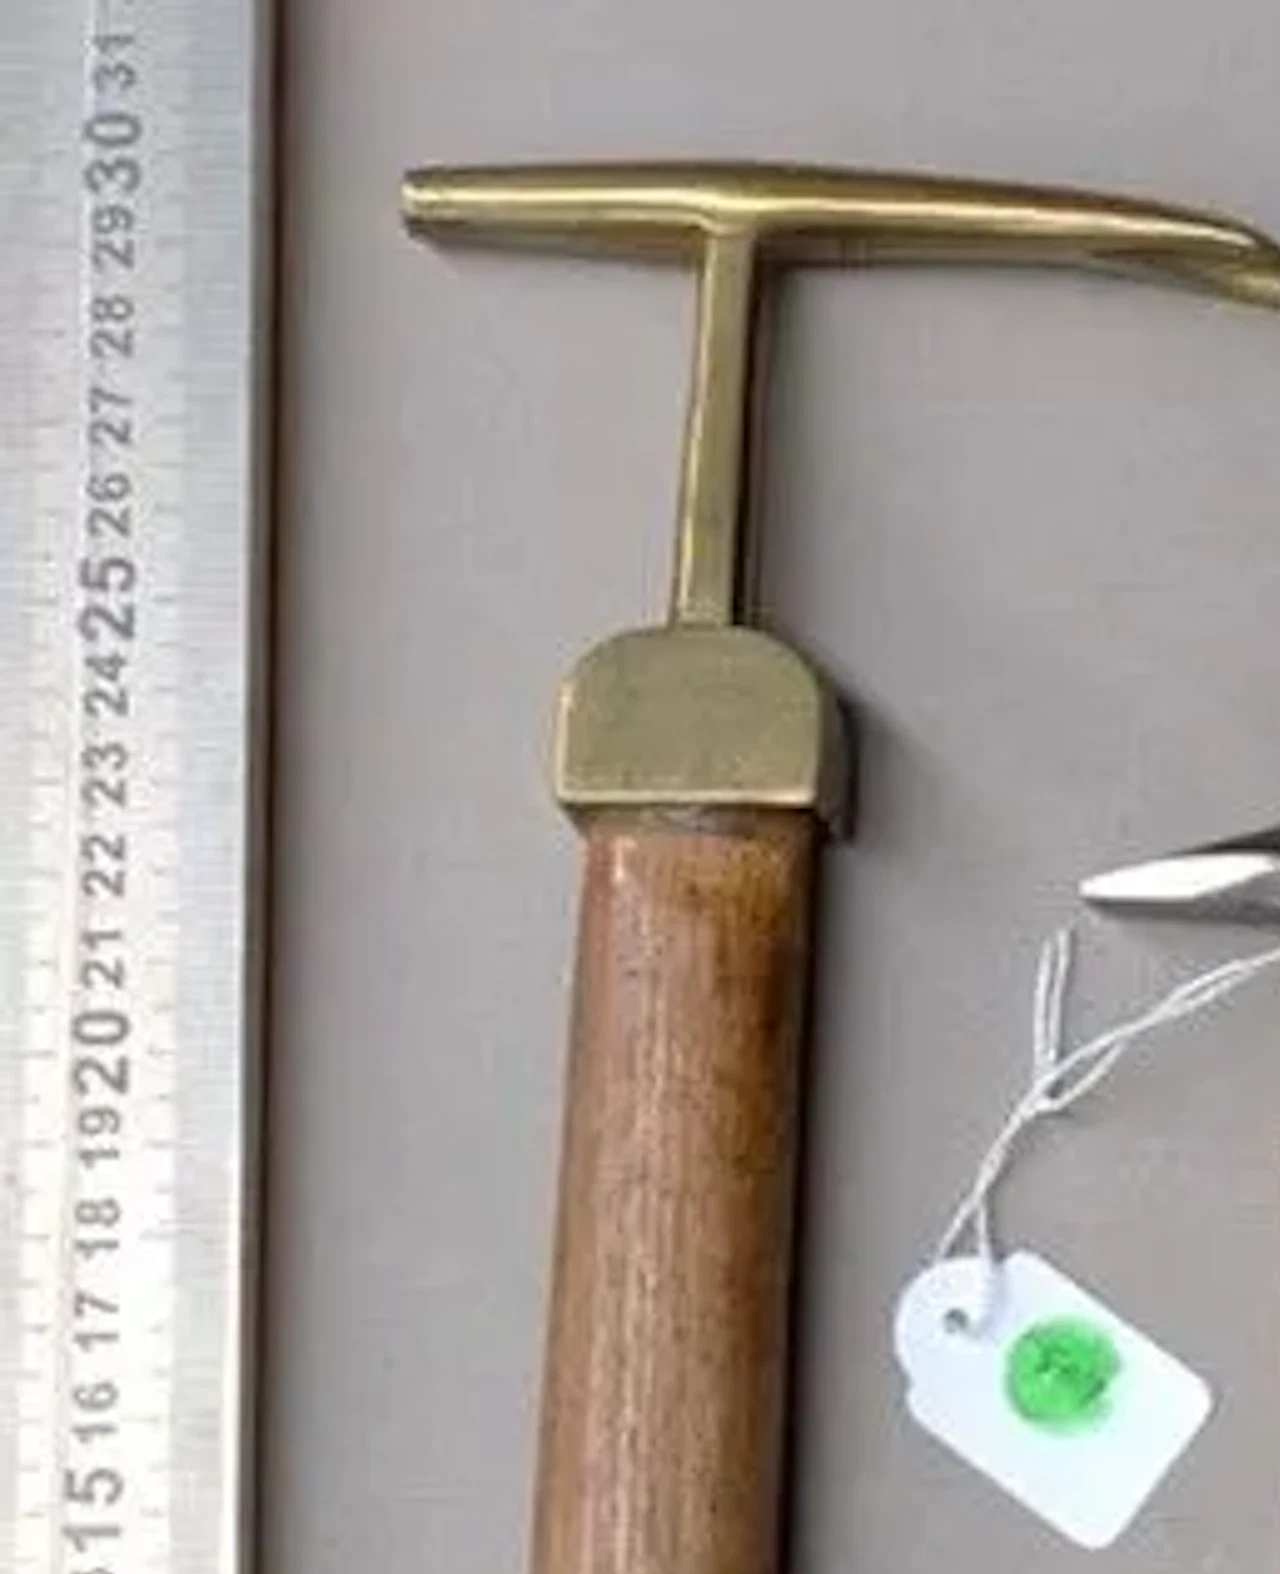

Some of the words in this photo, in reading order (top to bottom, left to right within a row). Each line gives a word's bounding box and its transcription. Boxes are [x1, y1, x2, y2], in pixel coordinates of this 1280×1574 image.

[93, 34, 137, 93] 31
[83, 112, 143, 194] 30
[91, 205, 135, 272] 29
[90, 295, 134, 358] 28
[88, 385, 132, 447] 27
[86, 473, 132, 537] 26
[78, 557, 136, 642] 25
[83, 652, 128, 717] 24
[81, 742, 129, 808] 23
[80, 834, 125, 897] 22
[78, 929, 125, 989] 21
[71, 1010, 131, 1096] 20
[75, 1106, 121, 1168] 19
[72, 1198, 121, 1259] 18
[72, 1290, 119, 1352] 17
[70, 1380, 119, 1443] 16
[60, 1468, 124, 1552] 15
